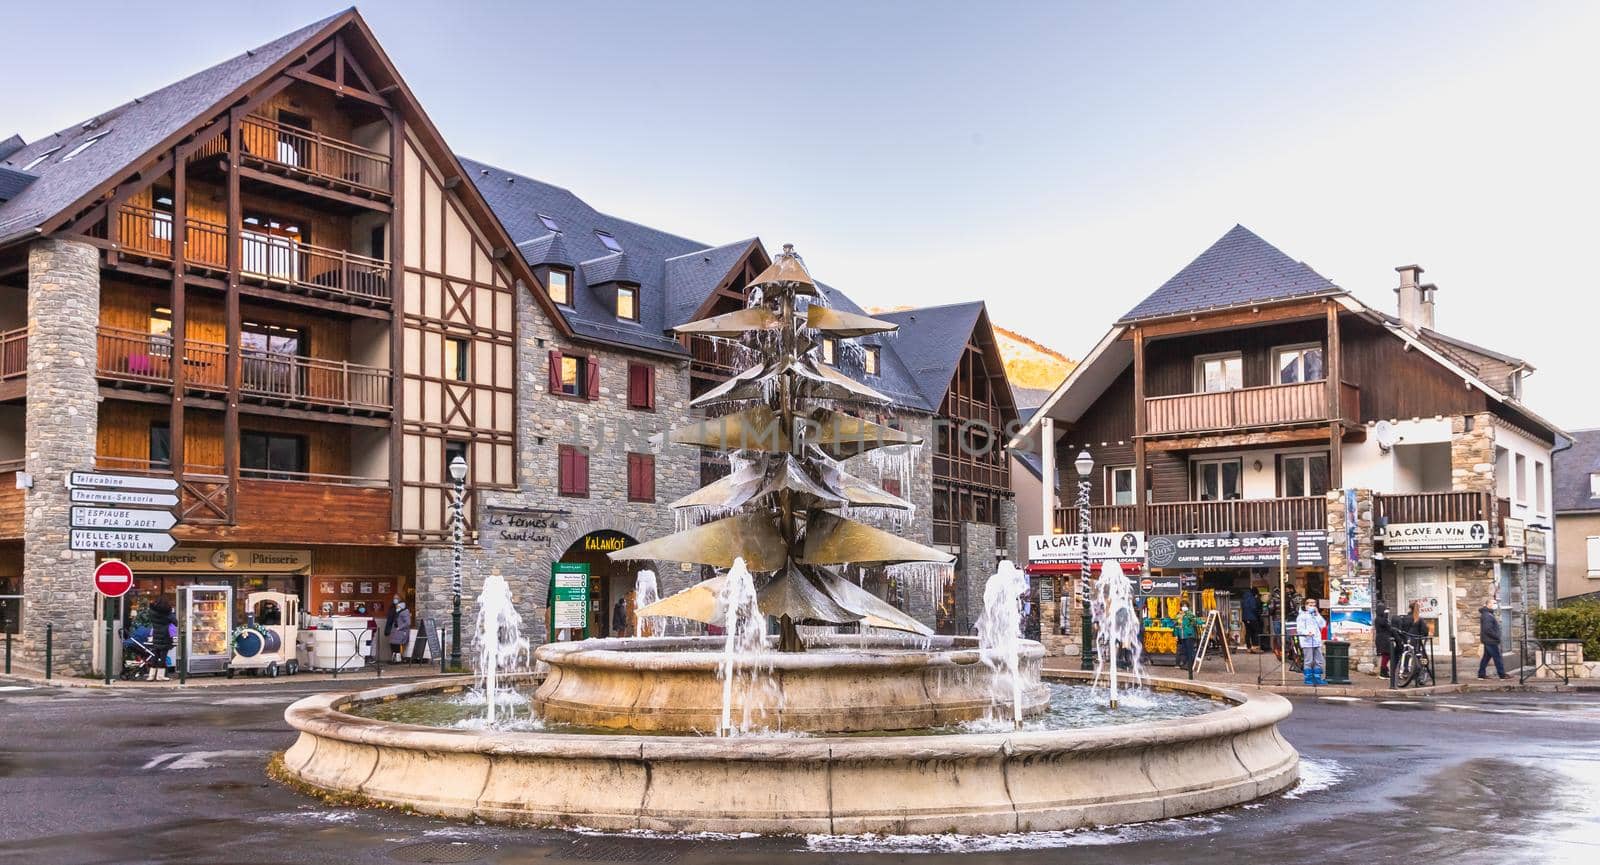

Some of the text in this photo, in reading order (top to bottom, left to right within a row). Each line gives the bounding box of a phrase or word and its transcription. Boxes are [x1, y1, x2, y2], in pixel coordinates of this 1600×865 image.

[76, 491, 153, 502] Thermes-Sensoria
[87, 510, 130, 518] ESPIAUBE
[75, 532, 140, 541] VIELLE-AURE
[1389, 527, 1465, 539] LA CAVE A VIN
[75, 540, 154, 550] VIGNEC-SOULAN
[1036, 535, 1112, 550] LA CAVE VIN
[1177, 538, 1215, 548] OFFICE
[1217, 537, 1240, 548] DES
[1242, 536, 1290, 547] SPORTS
[129, 552, 197, 565] Boulangerie
[252, 552, 298, 564] Pâtisserie
